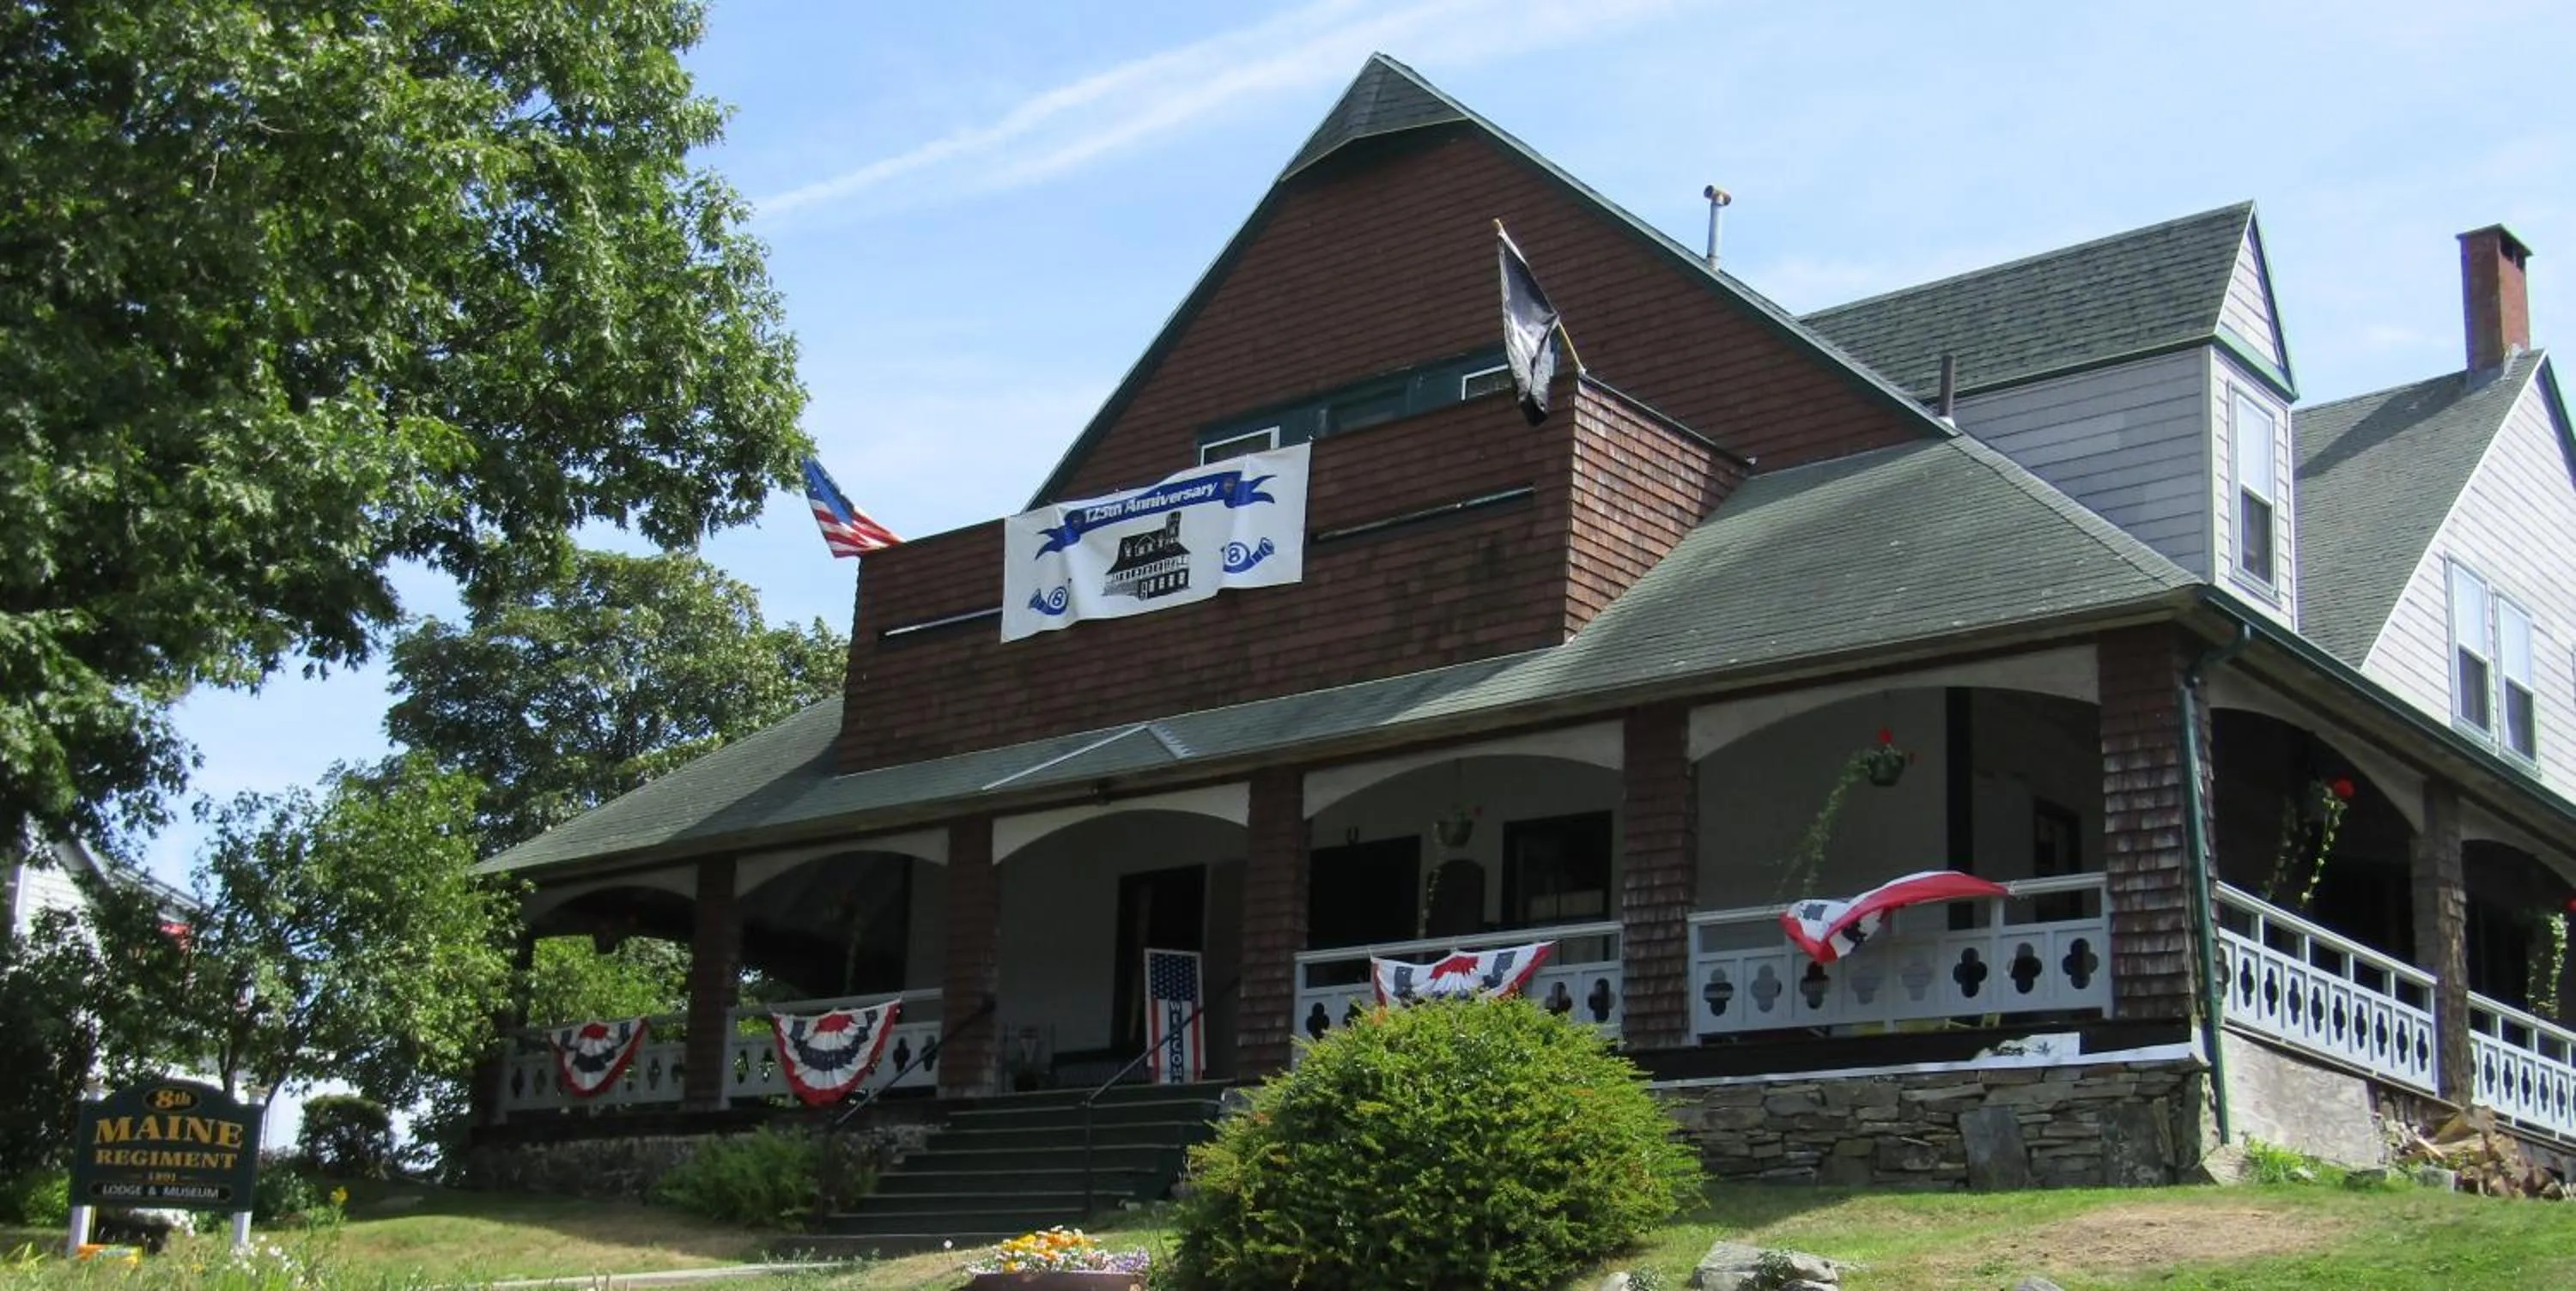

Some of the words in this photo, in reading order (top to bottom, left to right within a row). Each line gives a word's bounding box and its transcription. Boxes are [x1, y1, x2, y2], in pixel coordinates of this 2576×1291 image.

[1084, 504, 1122, 523] 125th
[1125, 482, 1218, 512] Anniversary
[1227, 546, 1242, 565] 8
[1052, 590, 1065, 608] 8
[155, 1090, 191, 1108] 8th
[94, 1115, 244, 1149] MAINE
[94, 1149, 238, 1168] REGIMENT
[102, 1184, 142, 1196] LODGE
[148, 1185, 157, 1196] &
[162, 1185, 219, 1197] MUSEUM
